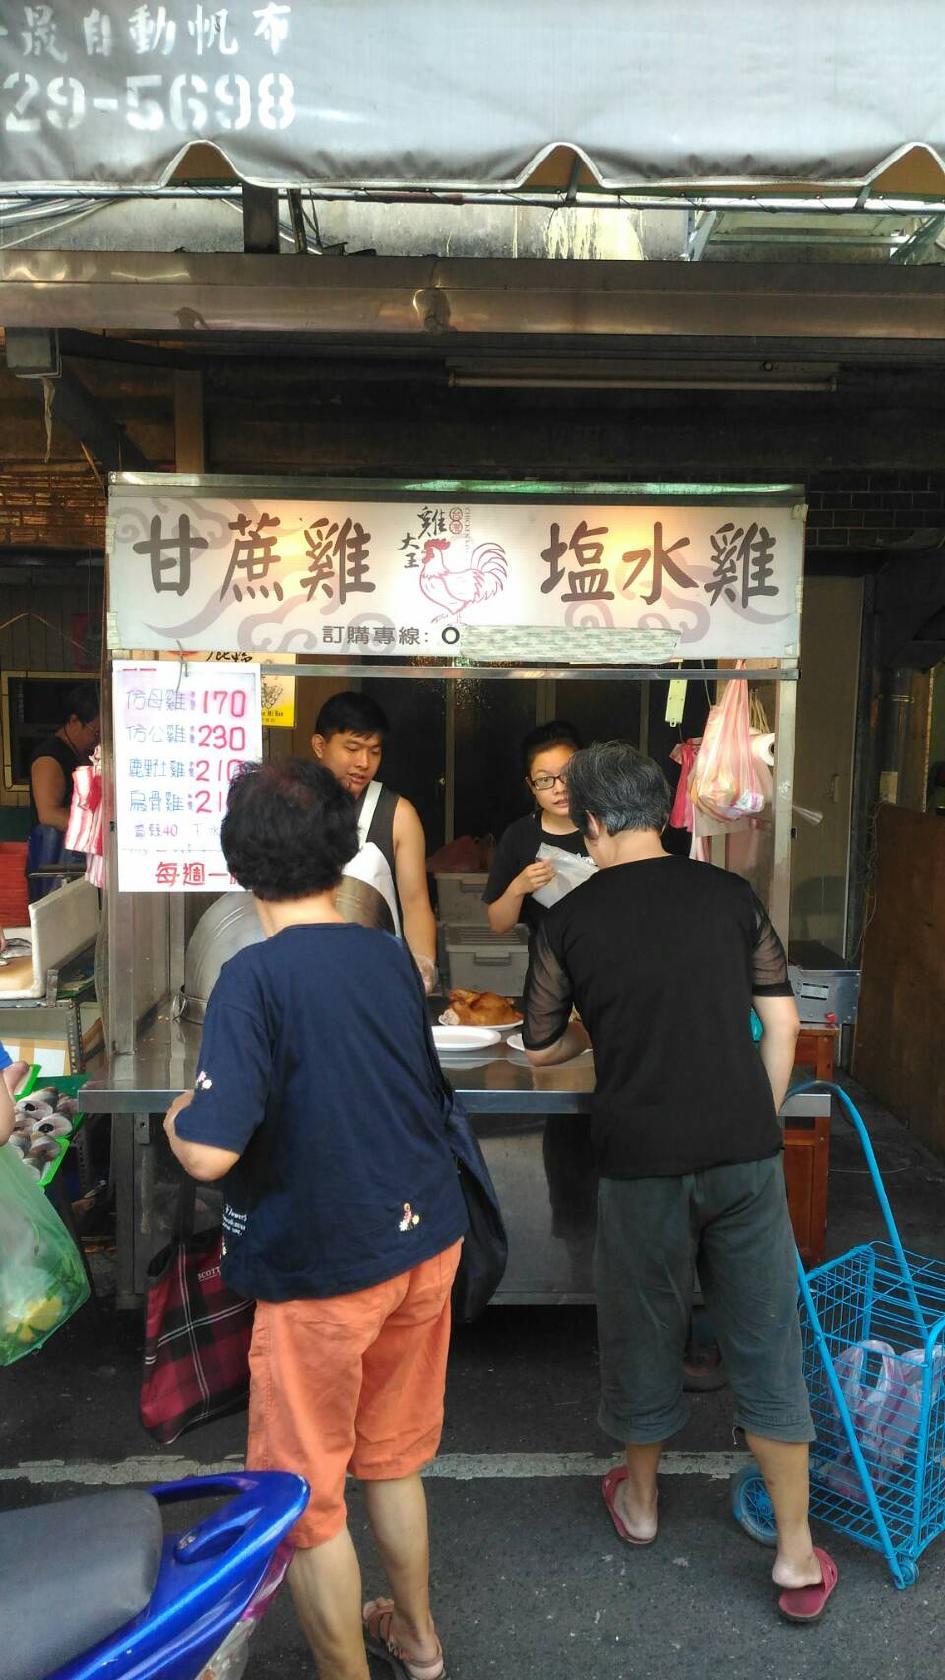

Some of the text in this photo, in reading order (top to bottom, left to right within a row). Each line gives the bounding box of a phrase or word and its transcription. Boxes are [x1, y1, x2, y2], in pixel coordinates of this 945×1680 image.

[132, 512, 376, 605] 甘蔗雞
[203, 690, 246, 717] 170
[198, 725, 246, 751] 230
[195, 790, 223, 813] 21
[155, 862, 238, 886] 每週一
